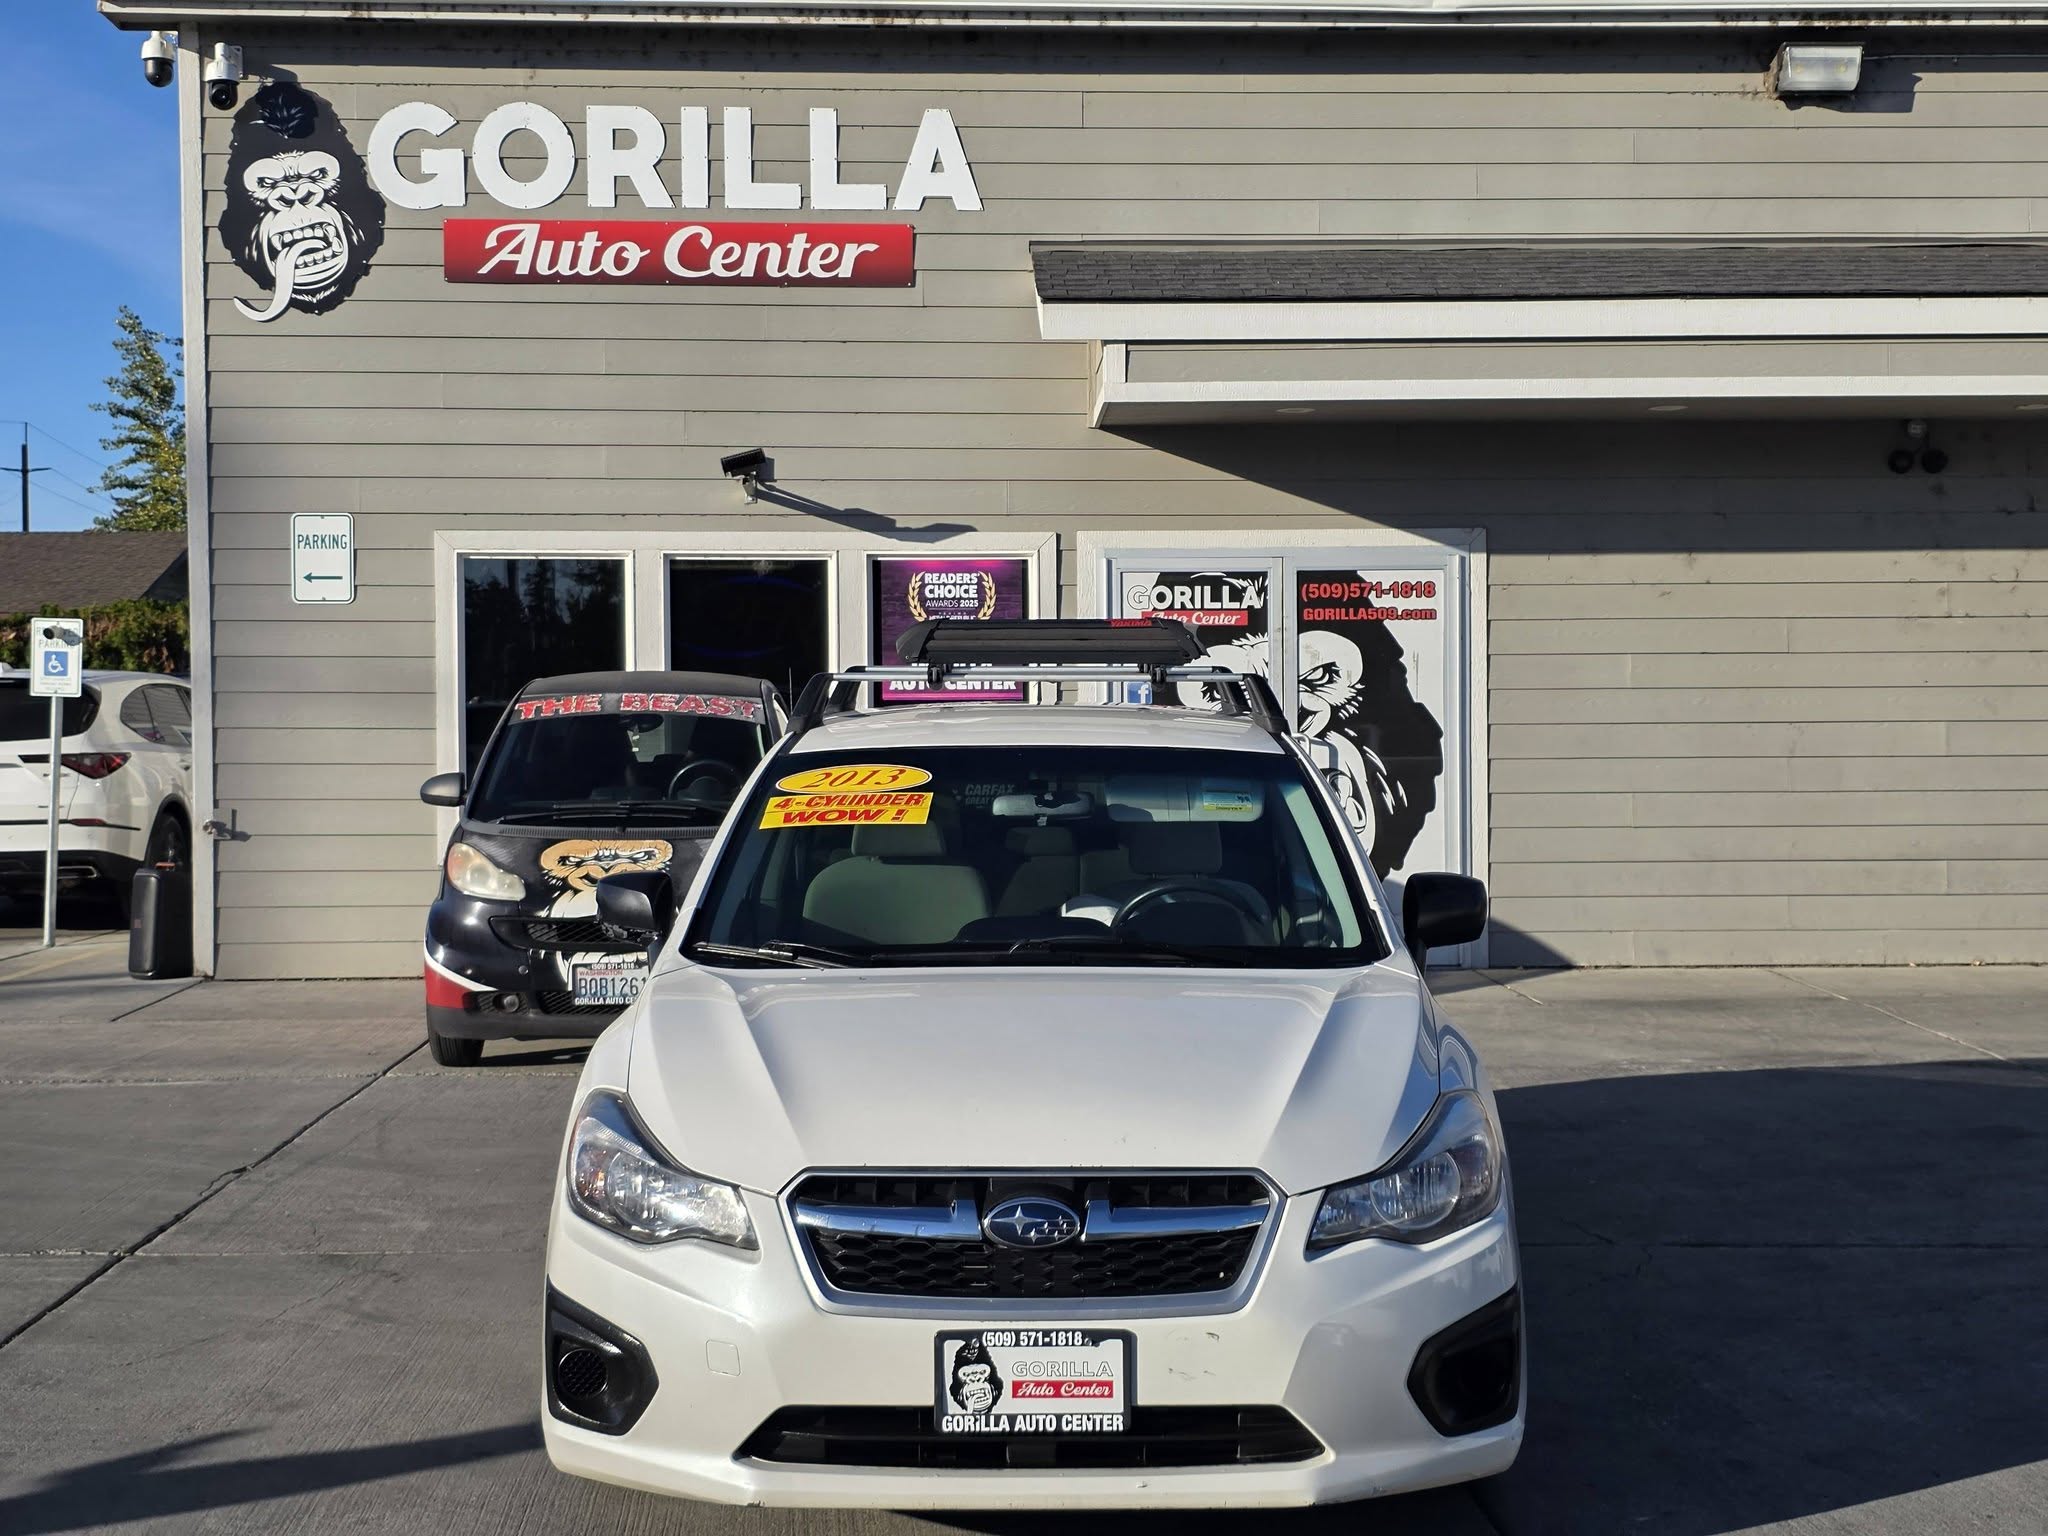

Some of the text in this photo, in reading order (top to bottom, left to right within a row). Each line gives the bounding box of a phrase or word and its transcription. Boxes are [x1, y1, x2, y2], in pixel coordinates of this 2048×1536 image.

[367, 101, 983, 212] GORILLA
[477, 223, 879, 279] Auto Center
[296, 534, 348, 550] PARKING
[924, 572, 980, 584] READERS'
[924, 585, 978, 599] CHOICE
[1126, 584, 1265, 611] GORILLA
[1301, 581, 1437, 602] (509)571-1818
[925, 599, 979, 608] AWARDS 2025
[1191, 611, 1241, 625] Center
[1302, 606, 1438, 622] GORILLA509.com
[889, 680, 1017, 690] AUT CENTER
[513, 692, 763, 720] THE BEAST
[800, 768, 907, 790] 2013
[965, 784, 1016, 796] CARFAX
[773, 792, 926, 811] 4-CYLINDER
[605, 996, 624, 1004] AUTO
[982, 1331, 1083, 1347] (509) 571-1818
[1012, 1360, 1114, 1377] GORILLA
[1016, 1382, 1111, 1397] Auto Center
[942, 1414, 1124, 1432] GORILLA AUTO CENTER
